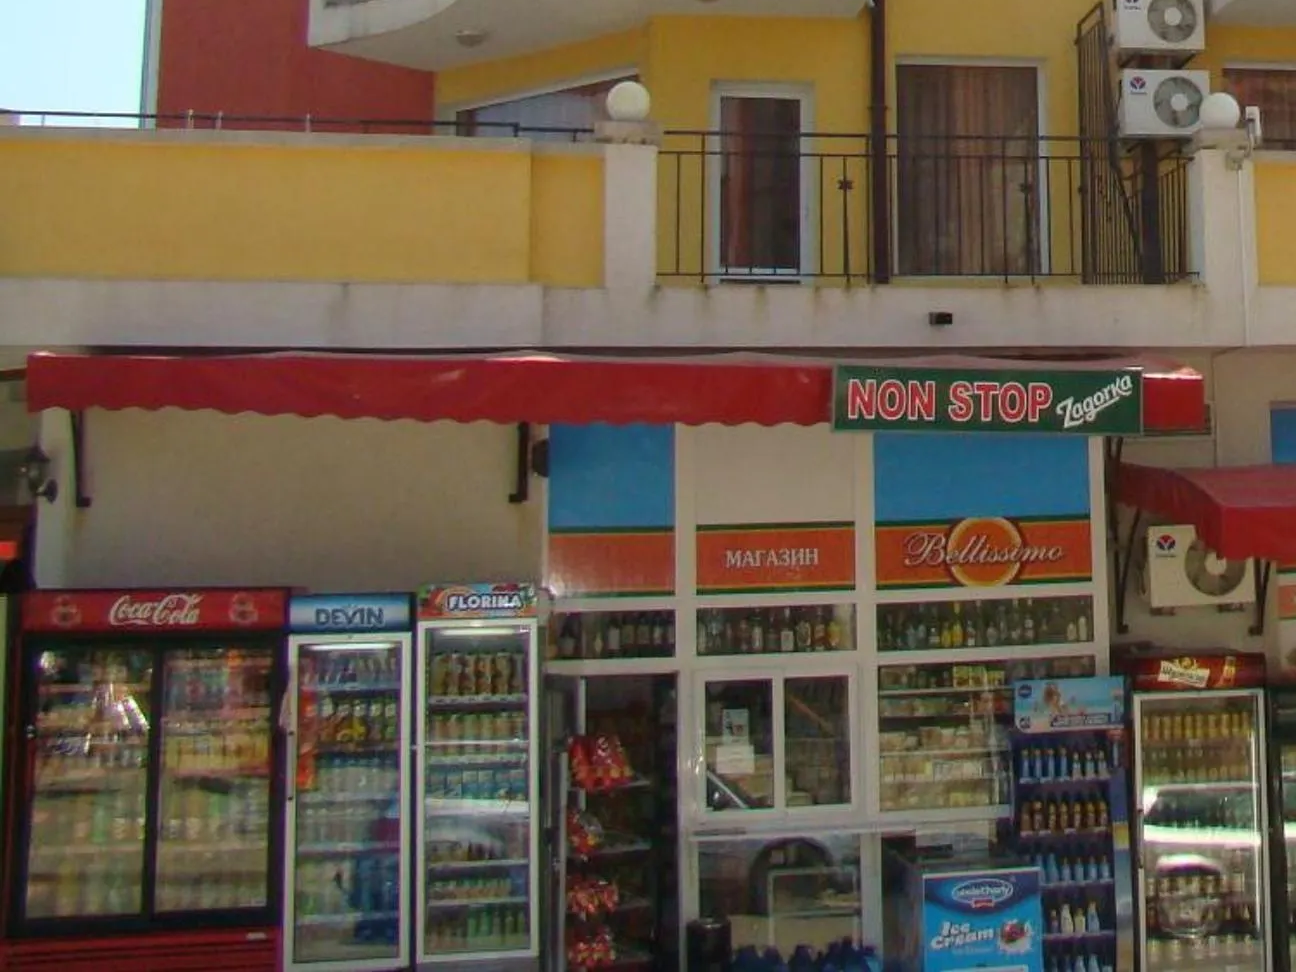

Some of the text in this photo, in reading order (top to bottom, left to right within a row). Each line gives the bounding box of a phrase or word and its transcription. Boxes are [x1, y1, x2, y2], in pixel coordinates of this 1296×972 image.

[848, 379, 1053, 422] NON STOP
[1056, 375, 1132, 428] Zagorka
[725, 547, 819, 569] МАГАЗИН
[904, 532, 1063, 567] Bellissimo
[109, 594, 204, 626] Coca-Cola
[315, 607, 384, 627] DEVIN
